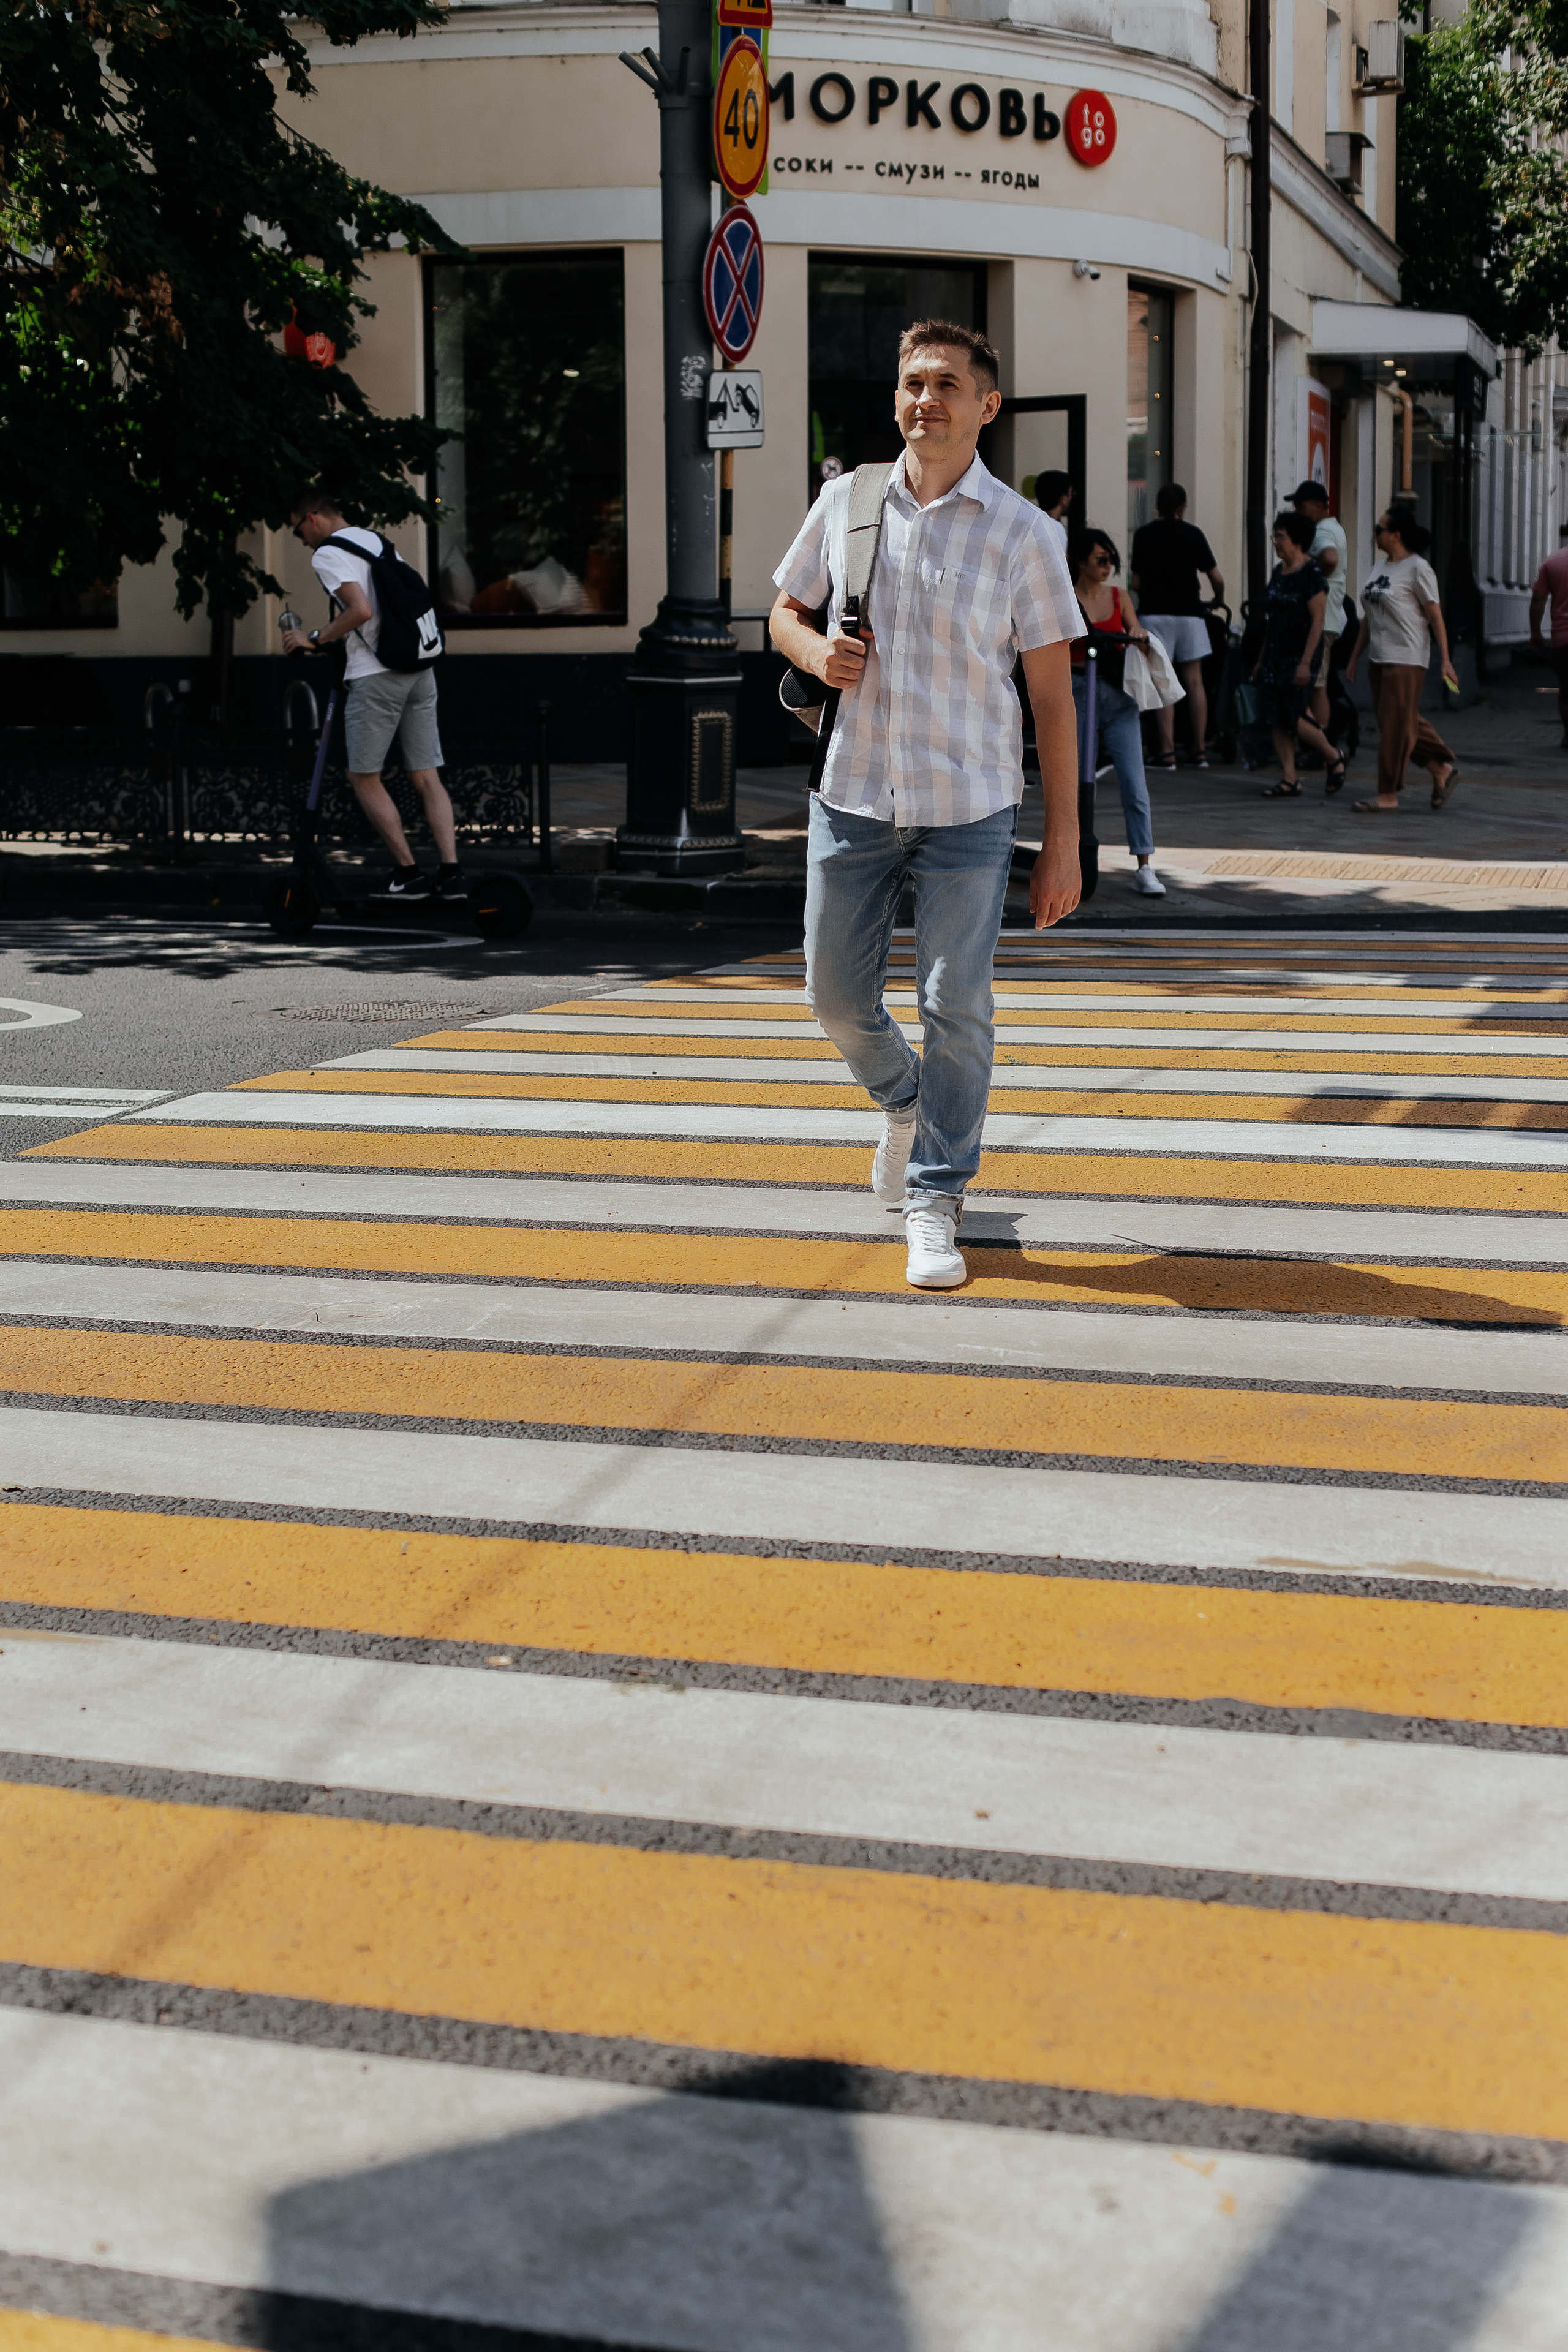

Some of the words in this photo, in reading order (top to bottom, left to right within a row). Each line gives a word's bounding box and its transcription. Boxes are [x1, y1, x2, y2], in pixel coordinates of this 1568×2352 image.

[724, 88, 759, 149] 40
[768, 70, 1061, 140] МОРКОВЬ
[1082, 103, 1105, 127] to
[1082, 126, 1106, 149] go
[773, 156, 833, 173] соки
[875, 160, 945, 184] смузи
[981, 168, 1039, 190] ягоды
